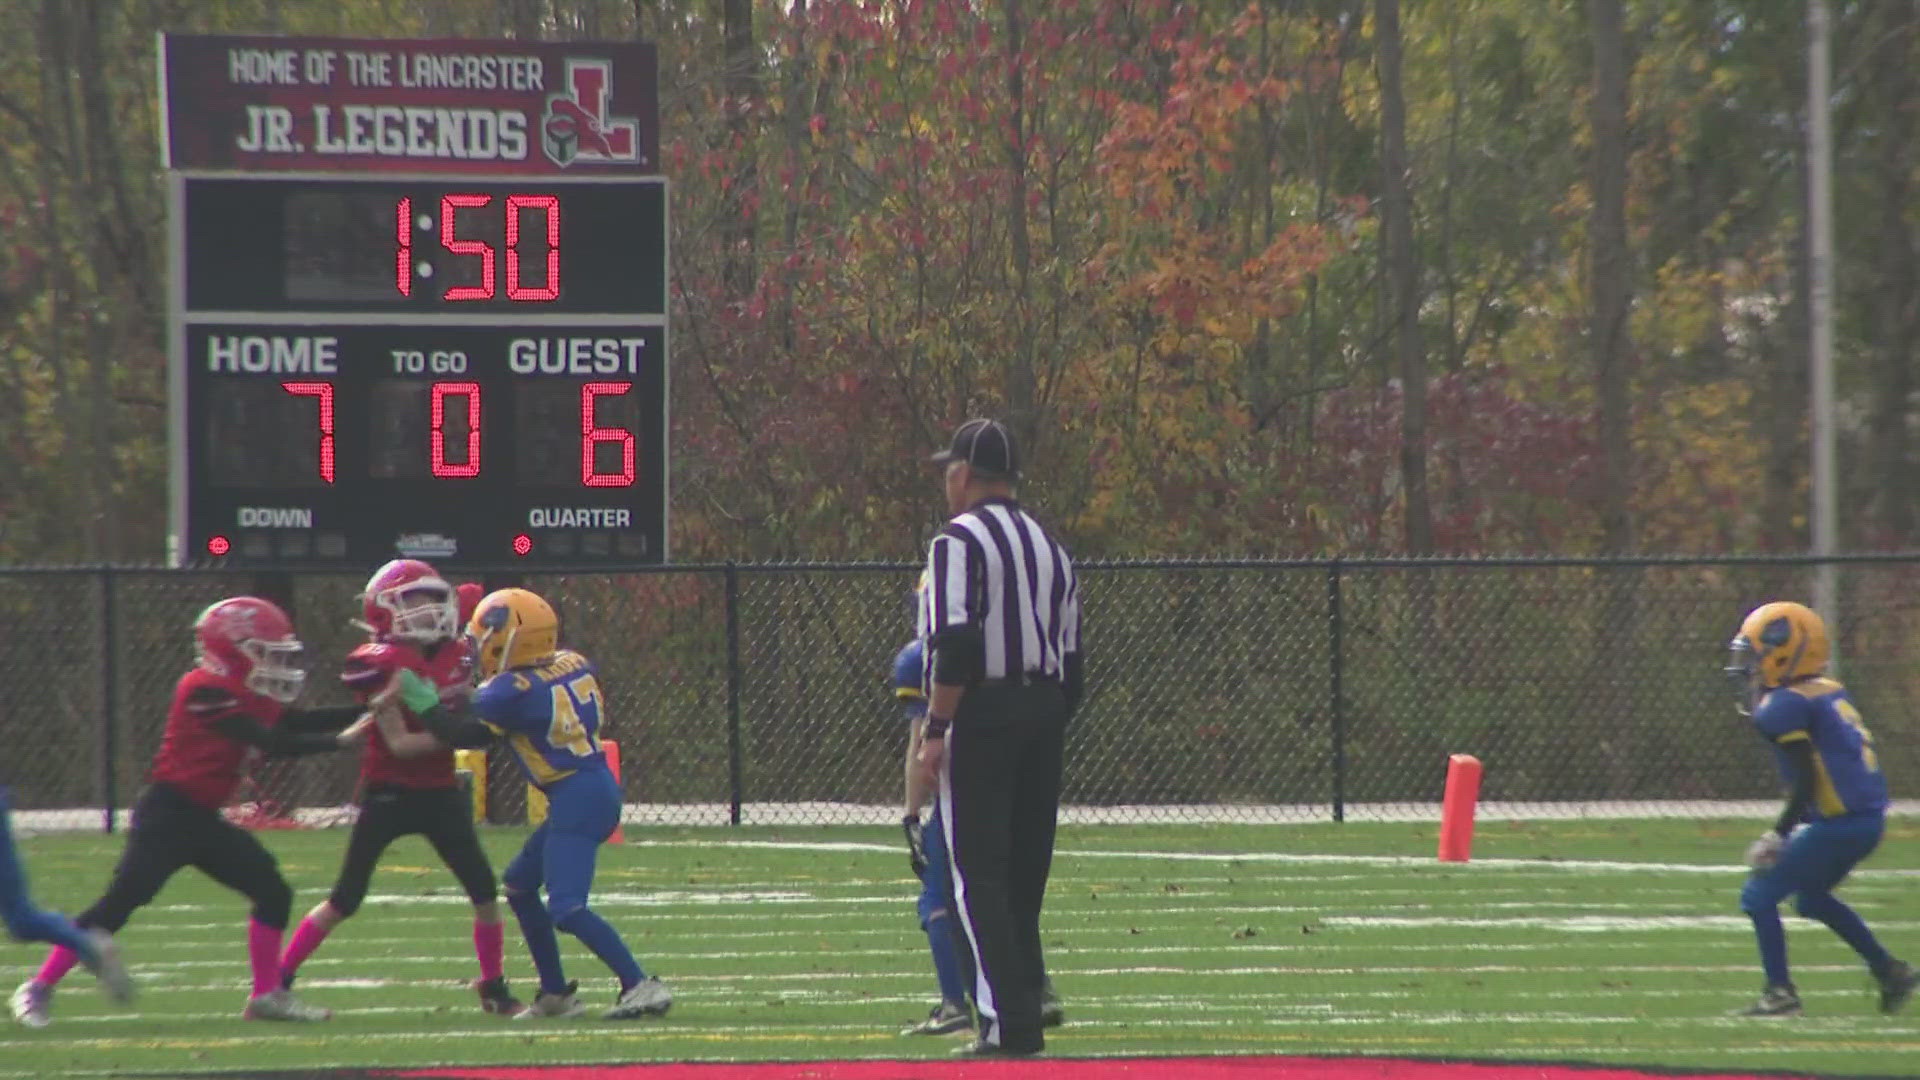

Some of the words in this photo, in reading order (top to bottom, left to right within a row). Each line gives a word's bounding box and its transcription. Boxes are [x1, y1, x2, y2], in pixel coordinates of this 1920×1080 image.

[229, 49, 300, 84] HOME
[305, 51, 336, 84] OF
[346, 52, 393, 87] THE
[401, 54, 543, 90] LANCASTER
[236, 105, 305, 152] JR.
[313, 105, 528, 160] LEGENDS
[396, 194, 560, 301] 1:50
[208, 336, 338, 374] HOME
[392, 351, 424, 374] TO
[431, 351, 467, 374] GO
[509, 338, 645, 374] GUEST
[281, 382, 335, 484] 7
[431, 382, 481, 479] 0
[581, 382, 636, 488] 6
[239, 507, 312, 529] DOWN
[529, 507, 631, 529] QUARTER
[546, 673, 605, 757] 47
